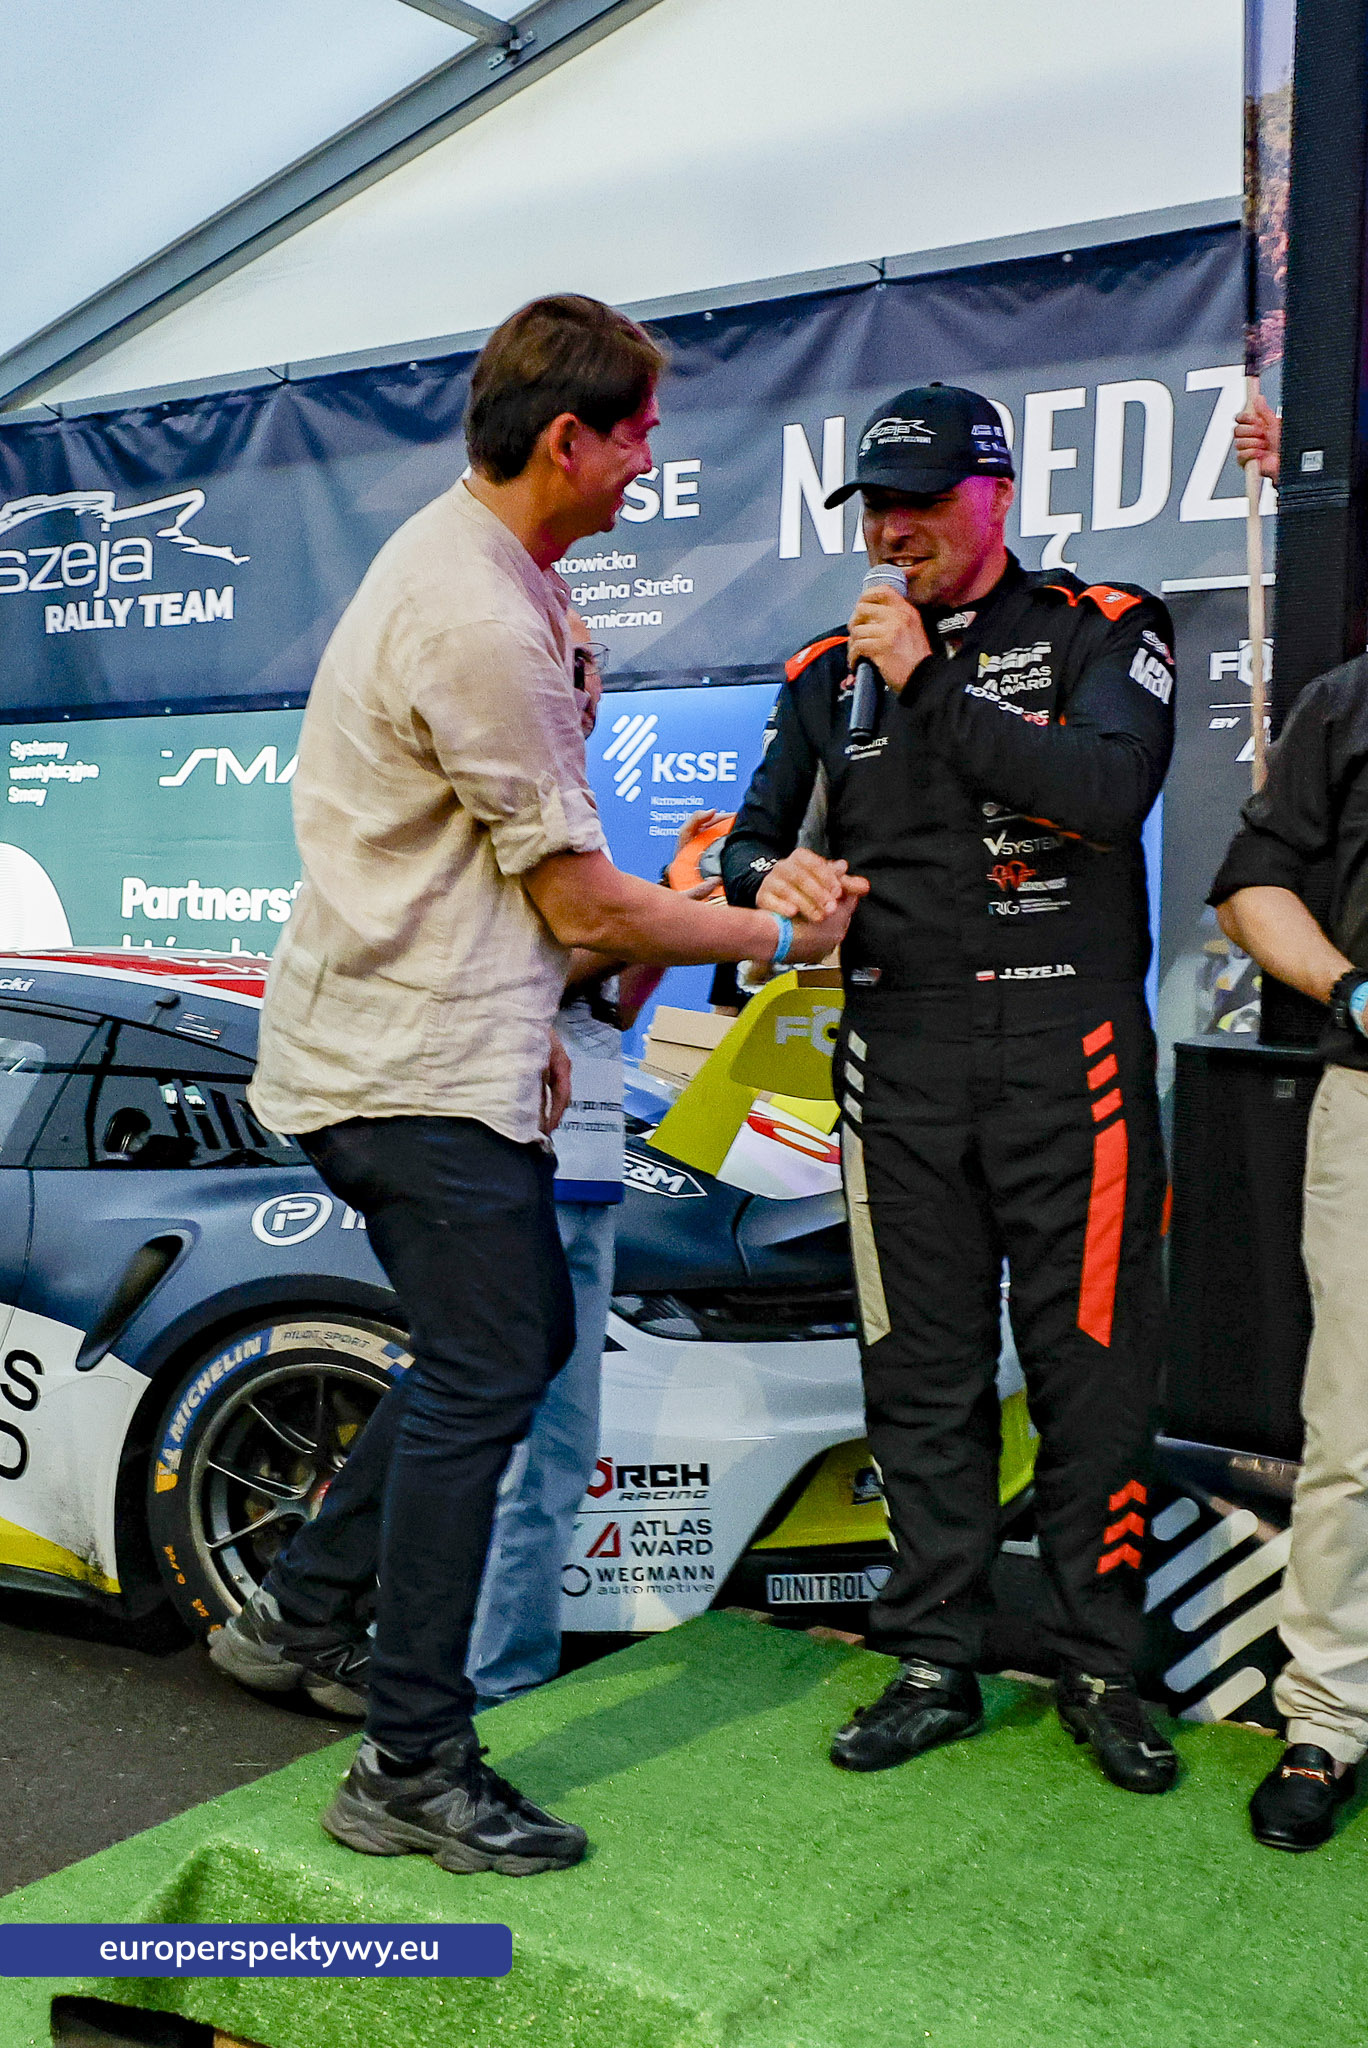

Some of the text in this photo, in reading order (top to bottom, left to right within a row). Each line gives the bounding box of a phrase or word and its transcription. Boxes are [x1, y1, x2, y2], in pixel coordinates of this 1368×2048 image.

[633, 574, 694, 597] Strefa
[45, 585, 235, 634] RALLY TEAM
[9, 740, 69, 761] Systemy
[651, 751, 739, 783] KSSE
[324, 1331, 371, 1348] SPORT
[170, 1336, 262, 1442] MICHELIN
[630, 1518, 712, 1537] ATLAS
[629, 1539, 713, 1557] WARD
[596, 1565, 715, 1582] WEGMANN
[597, 1583, 715, 1595] automotive
[771, 1575, 869, 1601] DINITROL
